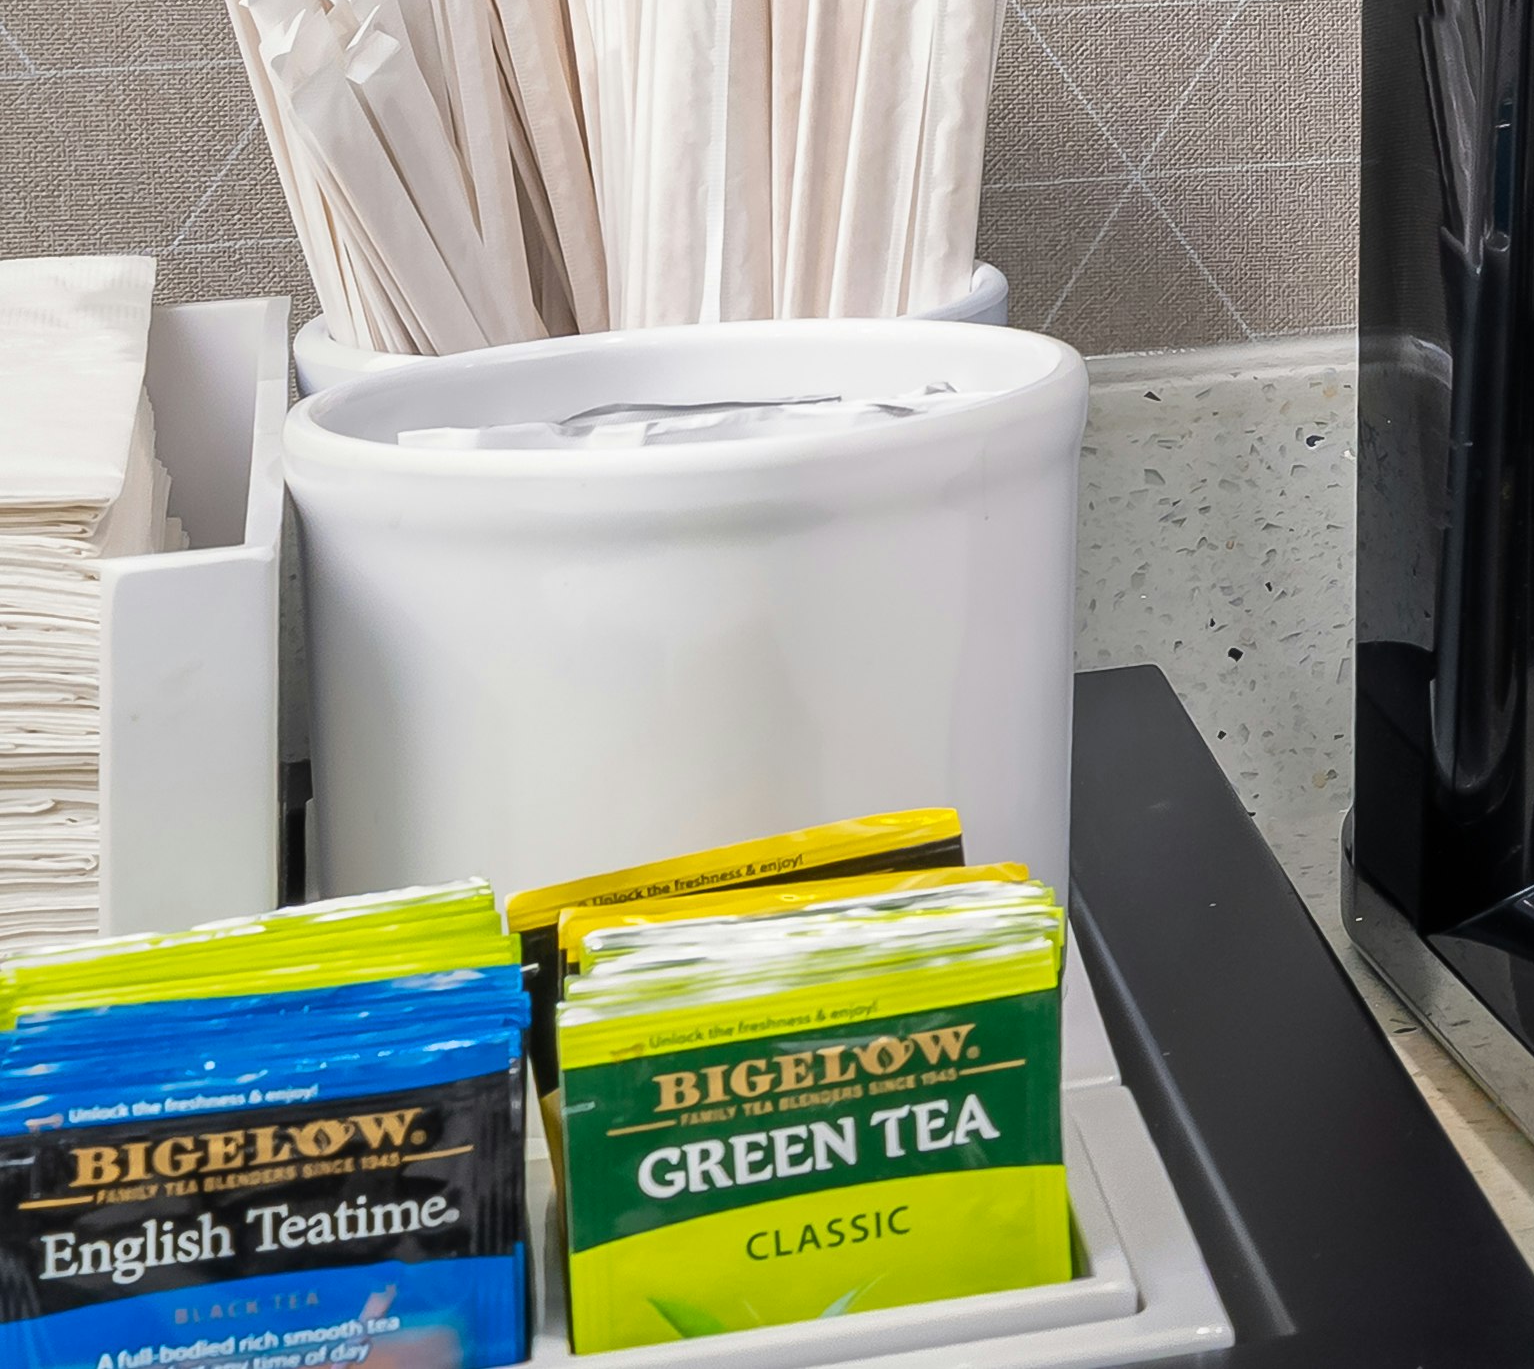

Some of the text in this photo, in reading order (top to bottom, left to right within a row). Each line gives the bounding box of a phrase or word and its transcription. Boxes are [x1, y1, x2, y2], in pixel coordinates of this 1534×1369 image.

[646, 882, 670, 897] the
[674, 868, 742, 892] freshness
[745, 864, 756, 876] &
[760, 854, 803, 873] enjoy!
[648, 1028, 704, 1051] Unlock
[708, 1024, 735, 1040] the
[738, 1013, 811, 1037] freshness
[652, 1023, 976, 1113] BIGELOW
[68, 1101, 130, 1125] Unlock
[132, 1098, 162, 1117] the
[164, 1091, 246, 1116] freshness
[681, 1105, 737, 1127] FAMILY
[744, 1100, 774, 1118] TEA
[778, 1084, 863, 1112] BLENDERS
[868, 1075, 916, 1096] SINCE
[68, 1106, 427, 1189] BIGELOW
[637, 1093, 1000, 1200] GREEN TEA
[163, 1179, 199, 1198] TEA
[203, 1165, 297, 1192] BLENDERS
[302, 1158, 359, 1181] SINCE
[39, 1211, 235, 1285] English
[745, 1205, 910, 1261] CLASSIC
[175, 1291, 320, 1325] BLACK TEA
[97, 1316, 400, 1369] A full-bodied rich smooth tea
[305, 1344, 327, 1365] of
[330, 1342, 371, 1364] day
